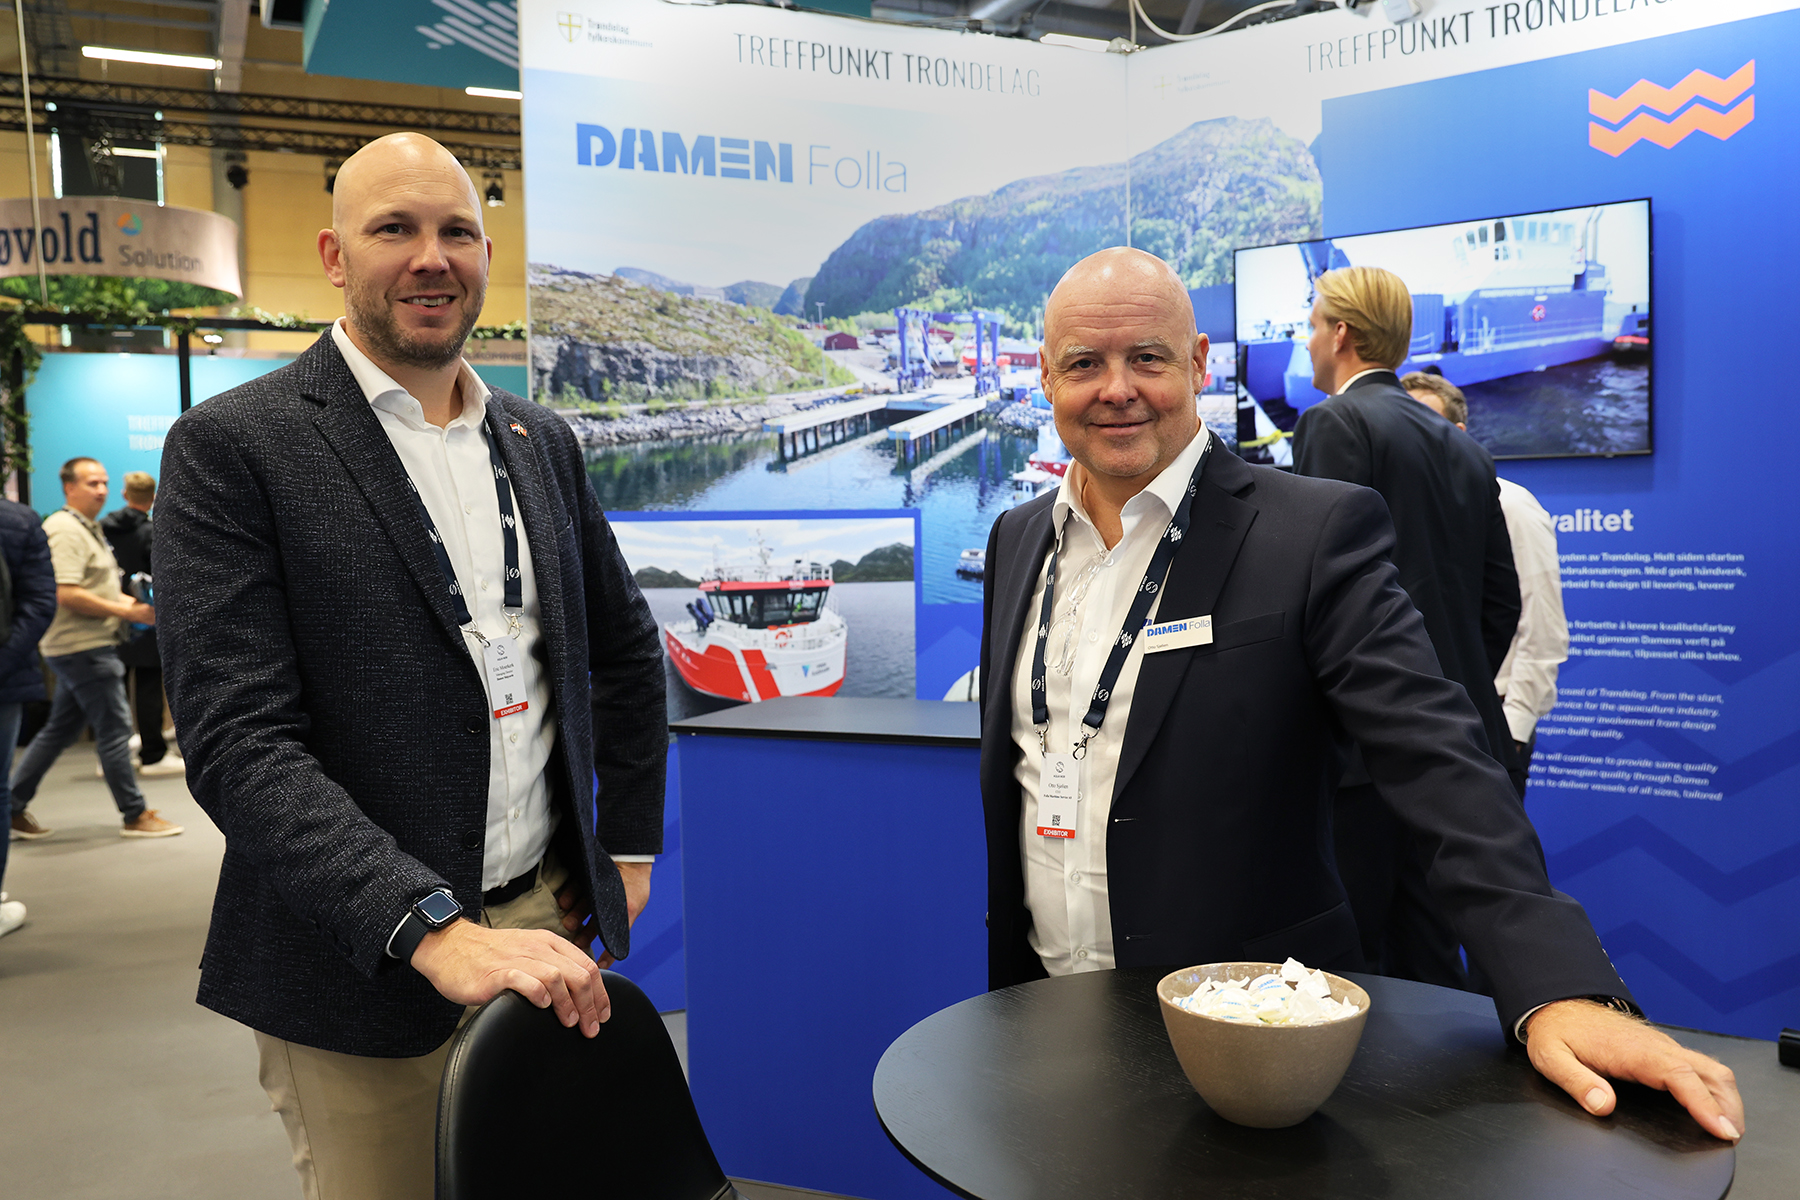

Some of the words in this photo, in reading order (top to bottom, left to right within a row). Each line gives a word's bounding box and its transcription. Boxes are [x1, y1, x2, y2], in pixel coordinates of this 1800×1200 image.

[1305, 10, 1474, 73] TREFFPUNKT
[1485, 0, 1673, 38] TRØND
[733, 32, 893, 80] TREFFPUNKT
[902, 53, 1041, 97] TRØNDELAG
[576, 122, 794, 183] DAMEN
[809, 144, 907, 193] Folla
[119, 244, 204, 274] Solution
[1147, 623, 1187, 637] DAMEN
[1188, 619, 1211, 630] Folla
[500, 704, 523, 716] EXHIBITOR
[1043, 829, 1069, 837] EXHIBITOR
